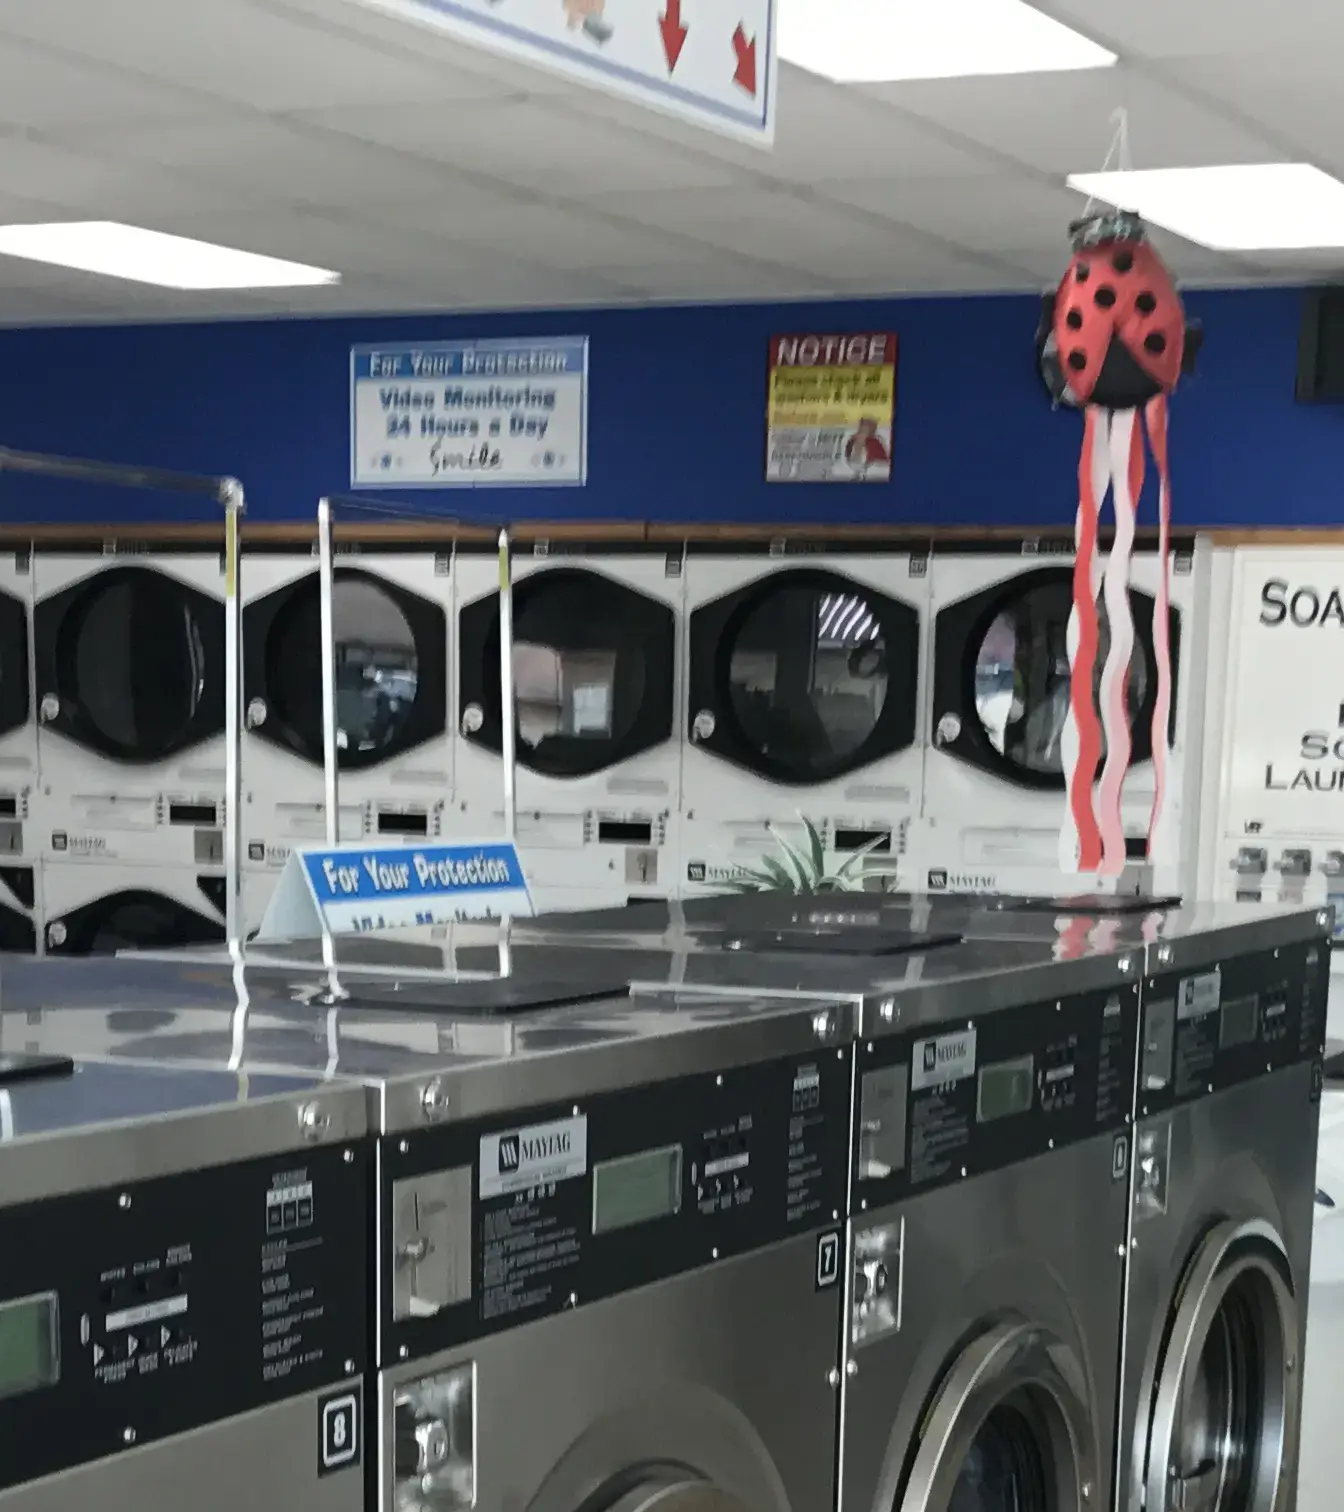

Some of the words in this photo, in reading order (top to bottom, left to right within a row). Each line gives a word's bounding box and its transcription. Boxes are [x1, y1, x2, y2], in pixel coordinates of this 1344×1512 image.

[370, 351, 401, 378] For
[410, 350, 454, 378] Your
[461, 348, 567, 378] Protection
[777, 333, 888, 366] NOTICE
[379, 385, 435, 411] Video
[444, 382, 556, 412] Monitoring
[420, 413, 479, 439] Hours
[510, 411, 549, 441] Day
[430, 437, 502, 476] Smile
[323, 857, 359, 894] For
[363, 853, 409, 892] Your
[413, 849, 510, 889] Protection
[522, 1130, 571, 1163] MAYTAG
[332, 1410, 348, 1448] 8
